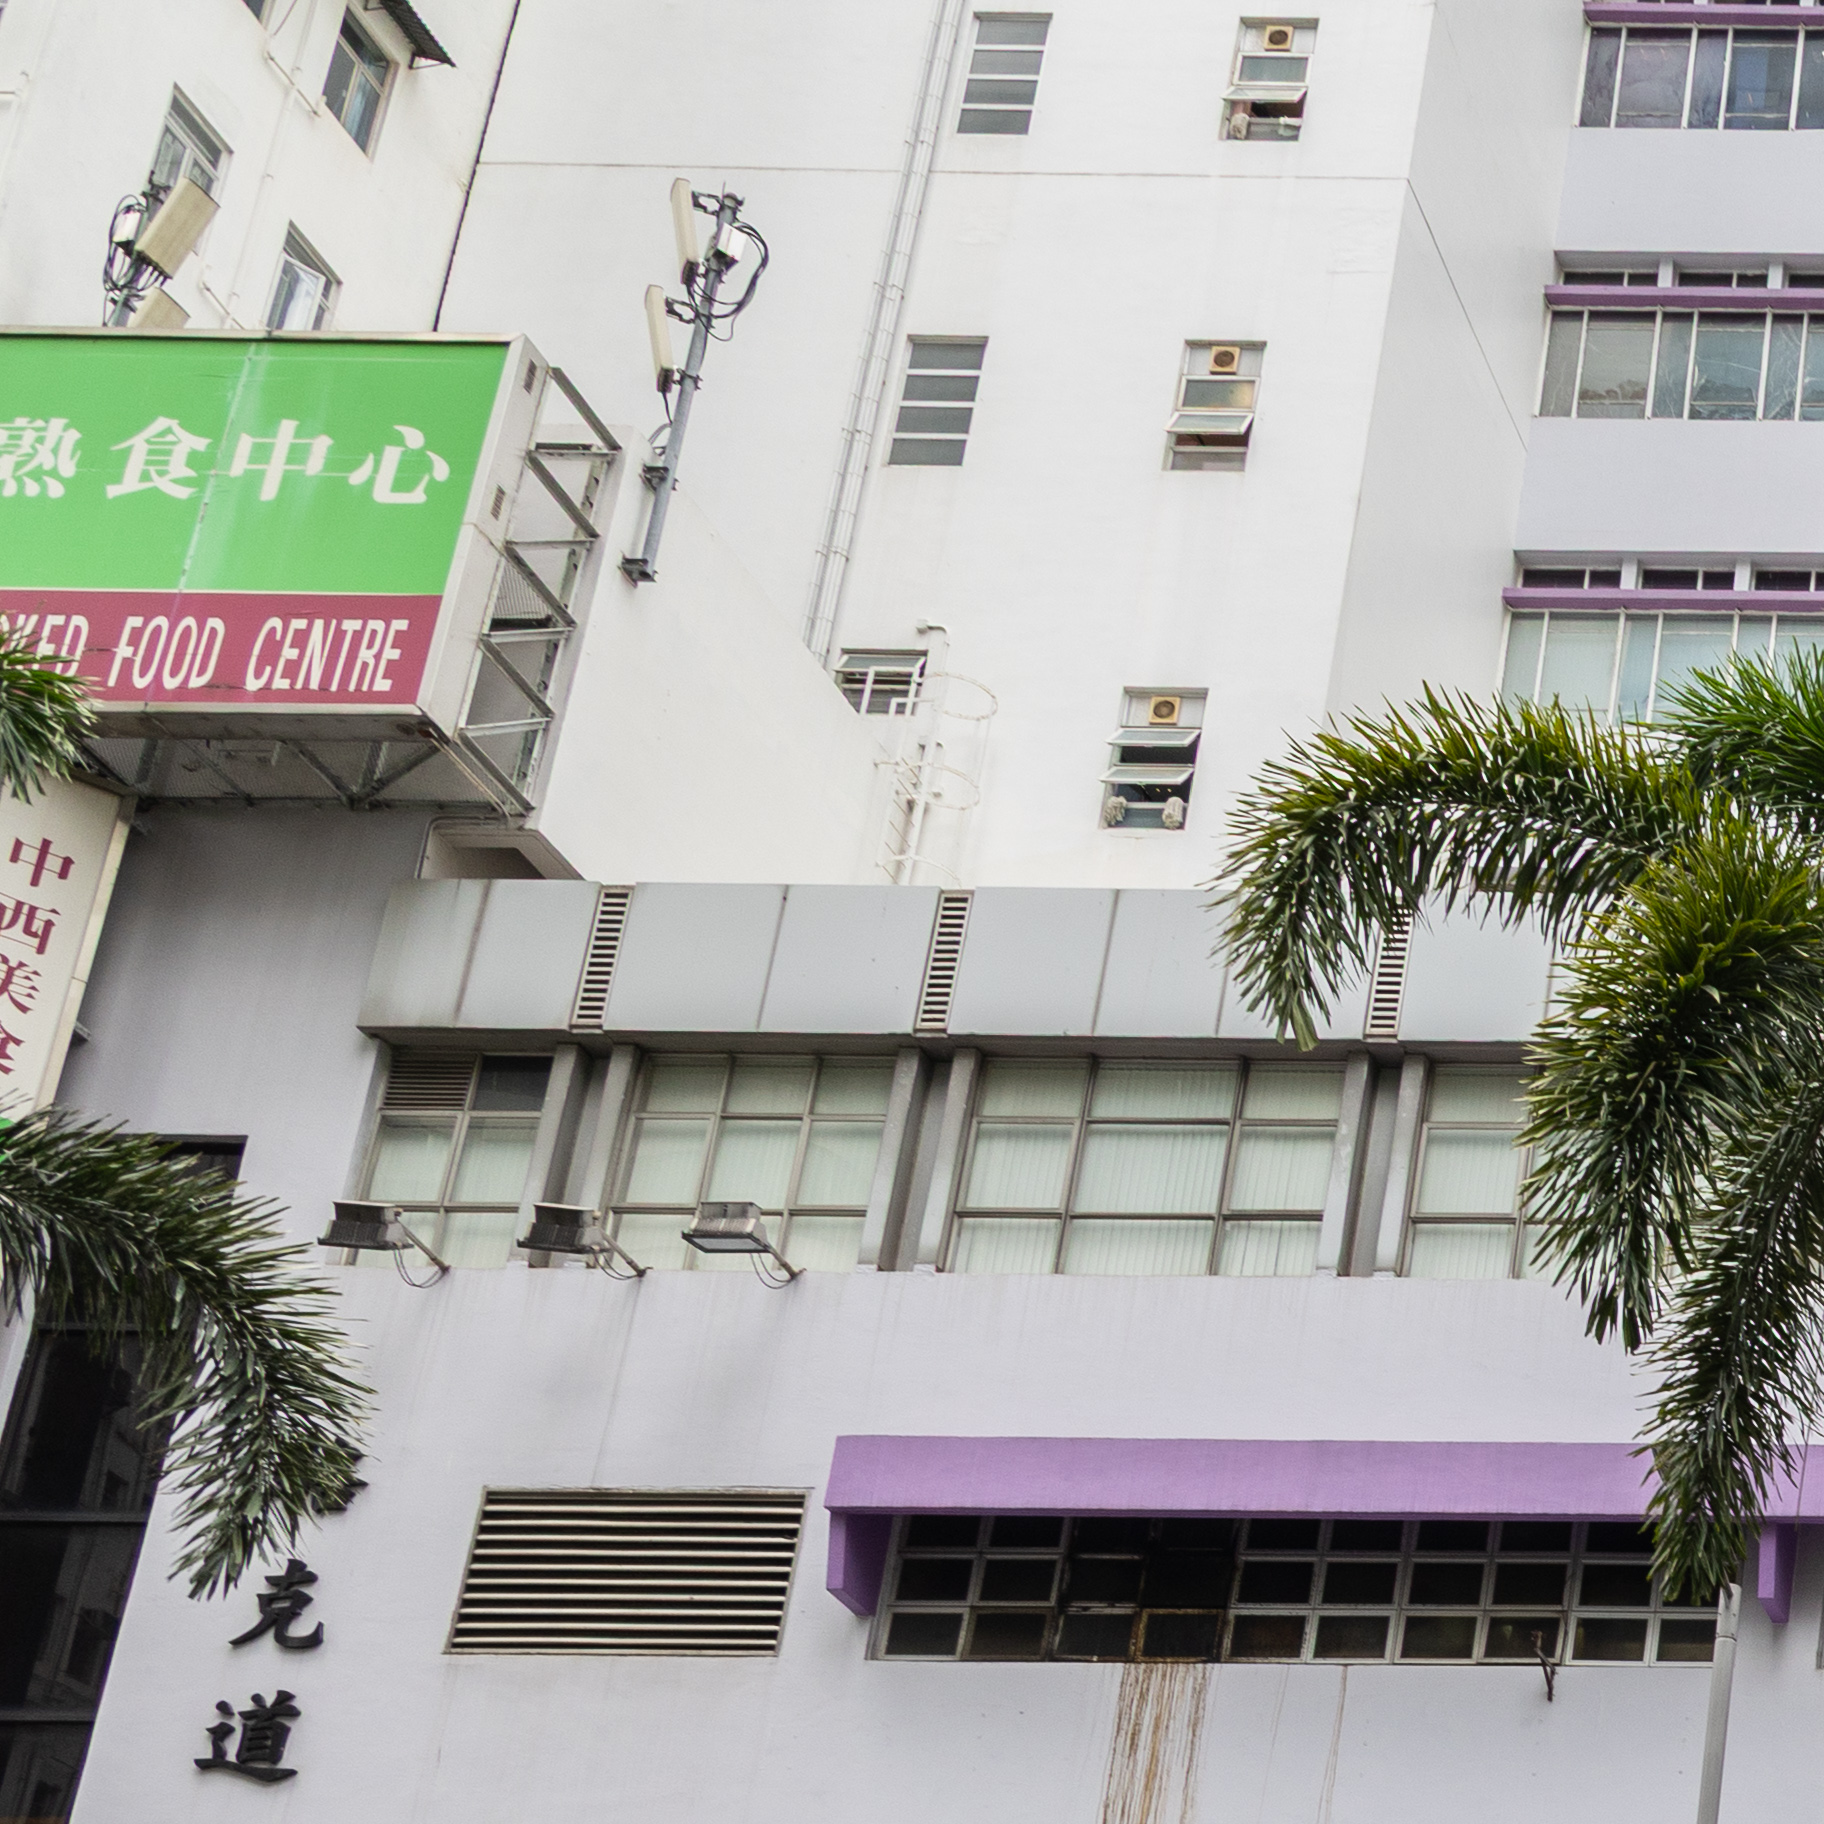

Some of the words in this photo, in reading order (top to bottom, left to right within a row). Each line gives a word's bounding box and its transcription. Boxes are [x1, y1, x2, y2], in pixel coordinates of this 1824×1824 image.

[0, 416, 451, 505] 熟食中心
[107, 615, 226, 690] FOOD
[245, 617, 409, 693] CENTRE
